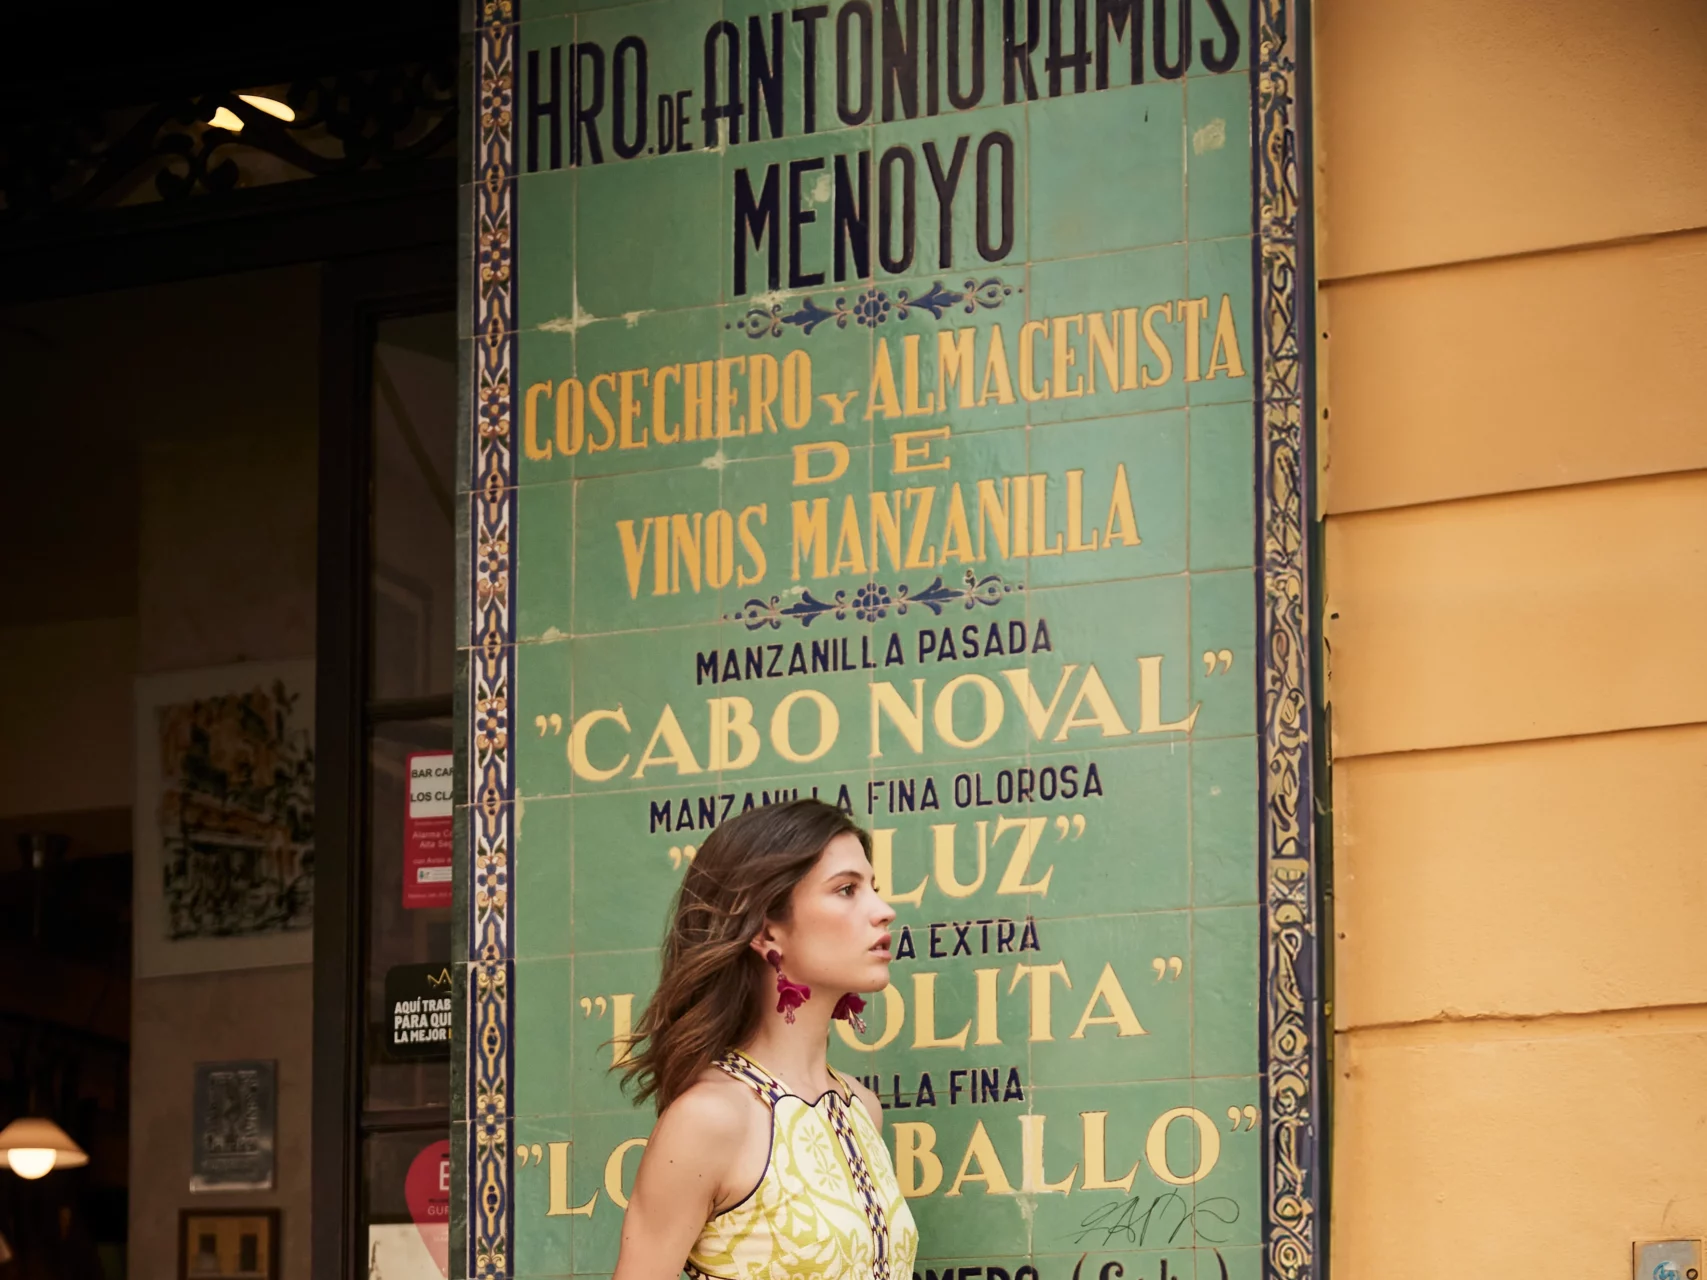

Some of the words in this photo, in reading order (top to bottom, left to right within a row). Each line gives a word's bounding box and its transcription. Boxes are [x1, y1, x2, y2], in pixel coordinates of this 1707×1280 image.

[700, 0, 985, 148] ANTONIO
[1002, 0, 1240, 105] RAMOS
[734, 131, 1014, 297] MENOYO
[523, 349, 812, 461] COSECHERO
[818, 390, 860, 426] Y
[864, 293, 1246, 421] ALMACENISTA
[615, 503, 768, 600] VINOS
[791, 462, 1142, 581] MANZANILLA
[696, 632, 905, 686] MANZANILLA
[918, 618, 1053, 664] PASADA
[411, 768, 433, 778] BAR
[867, 776, 939, 815] FINA
[954, 762, 1103, 809] OLOROSA
[411, 791, 432, 802] LOS
[929, 915, 1041, 959] EXTRA
[395, 995, 421, 1015] AQUÍ
[395, 1013, 429, 1030] PARA
[394, 1030, 409, 1044] LA
[410, 1027, 447, 1042] MEJOR
[950, 1066, 1025, 1105] FINA
